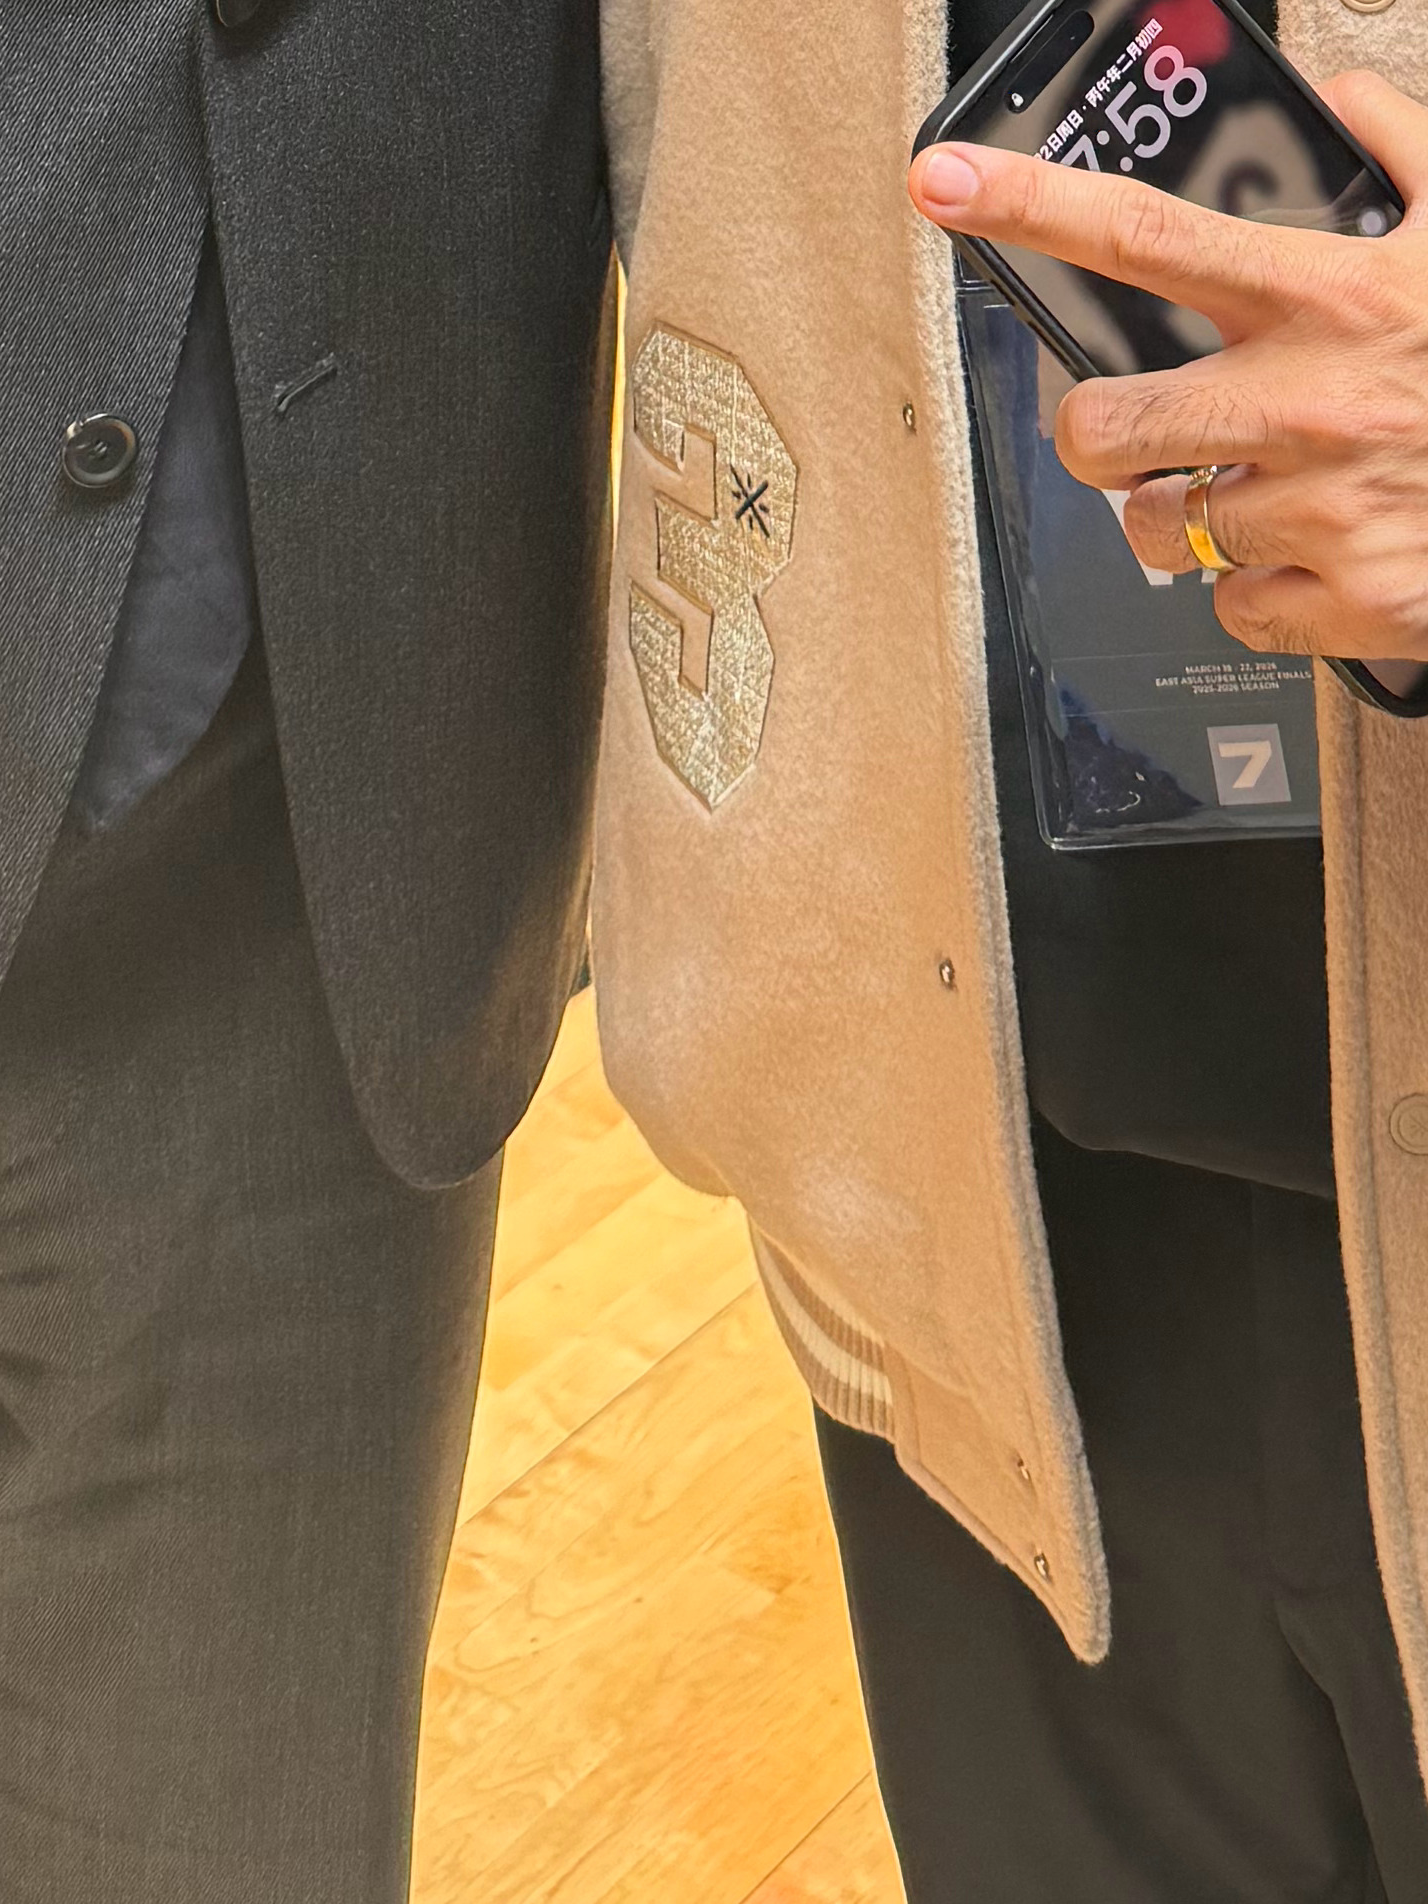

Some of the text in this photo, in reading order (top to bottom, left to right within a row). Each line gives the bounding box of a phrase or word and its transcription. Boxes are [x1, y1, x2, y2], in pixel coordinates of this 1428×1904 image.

[1059, 45, 1207, 172] 7:58
[1185, 664, 1221, 675] MARCH
[1155, 670, 1312, 687] EAST ASIA SUPER LEAGUE FINALS
[1241, 680, 1280, 691] SEASON
[1218, 740, 1272, 789] 7
